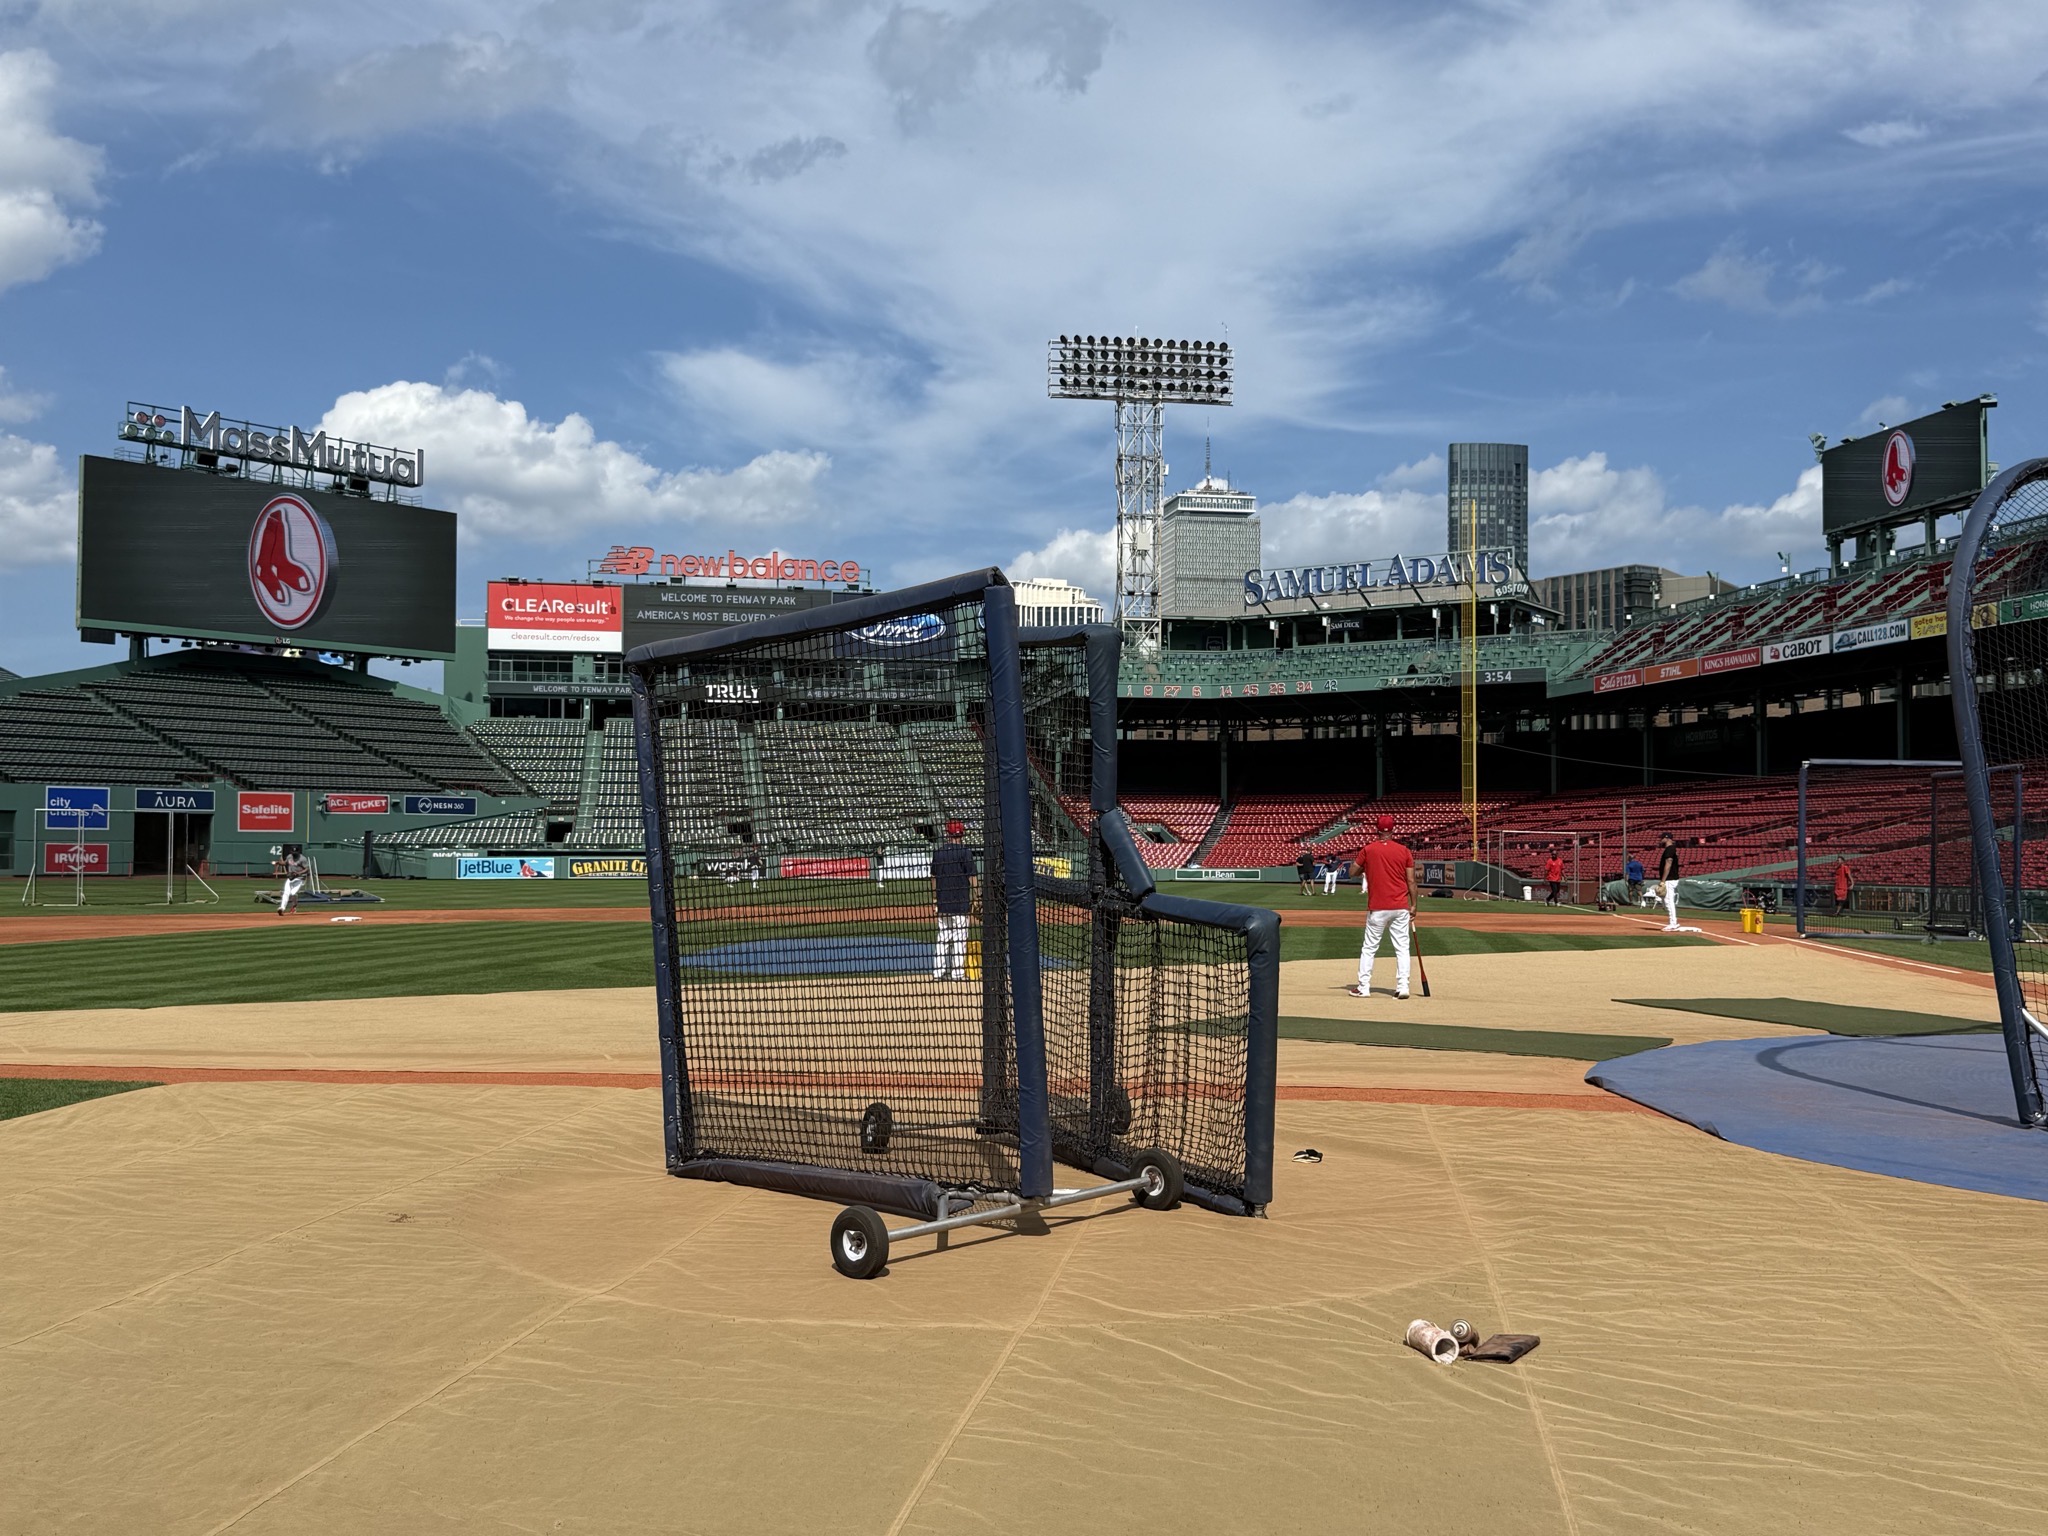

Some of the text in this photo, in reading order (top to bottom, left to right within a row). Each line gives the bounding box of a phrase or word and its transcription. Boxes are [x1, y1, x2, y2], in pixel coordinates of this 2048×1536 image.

[181, 405, 423, 487] MassMutual
[1244, 552, 1513, 607] SAMUEL ADAMS
[1495, 583, 1529, 597] BOSTON
[661, 593, 796, 606] WELCOME TO FENWAY PARK
[636, 610, 690, 620] AMERICA'S
[692, 611, 720, 621] MOST
[511, 632, 601, 642] clearesult.com/redsox
[1857, 623, 1906, 645] CALL128.COM
[1724, 652, 1757, 667] HAWAIIAN
[1485, 671, 1512, 682] 3:54
[1660, 666, 1682, 678] STIHL
[1616, 674, 1637, 687] PIZZA
[533, 685, 568, 693] WELCOME
[705, 685, 760, 699] TRULY
[1164, 686, 1181, 698] 27
[1219, 685, 1232, 698] 14
[1269, 682, 1286, 695] 26
[1324, 679, 1338, 692] 42
[50, 797, 71, 808] city
[351, 799, 386, 811] TICKET
[242, 804, 290, 815] Safelite
[270, 845, 282, 856] 42
[463, 859, 512, 877] jetBlue
[572, 860, 628, 875] GRANITE
